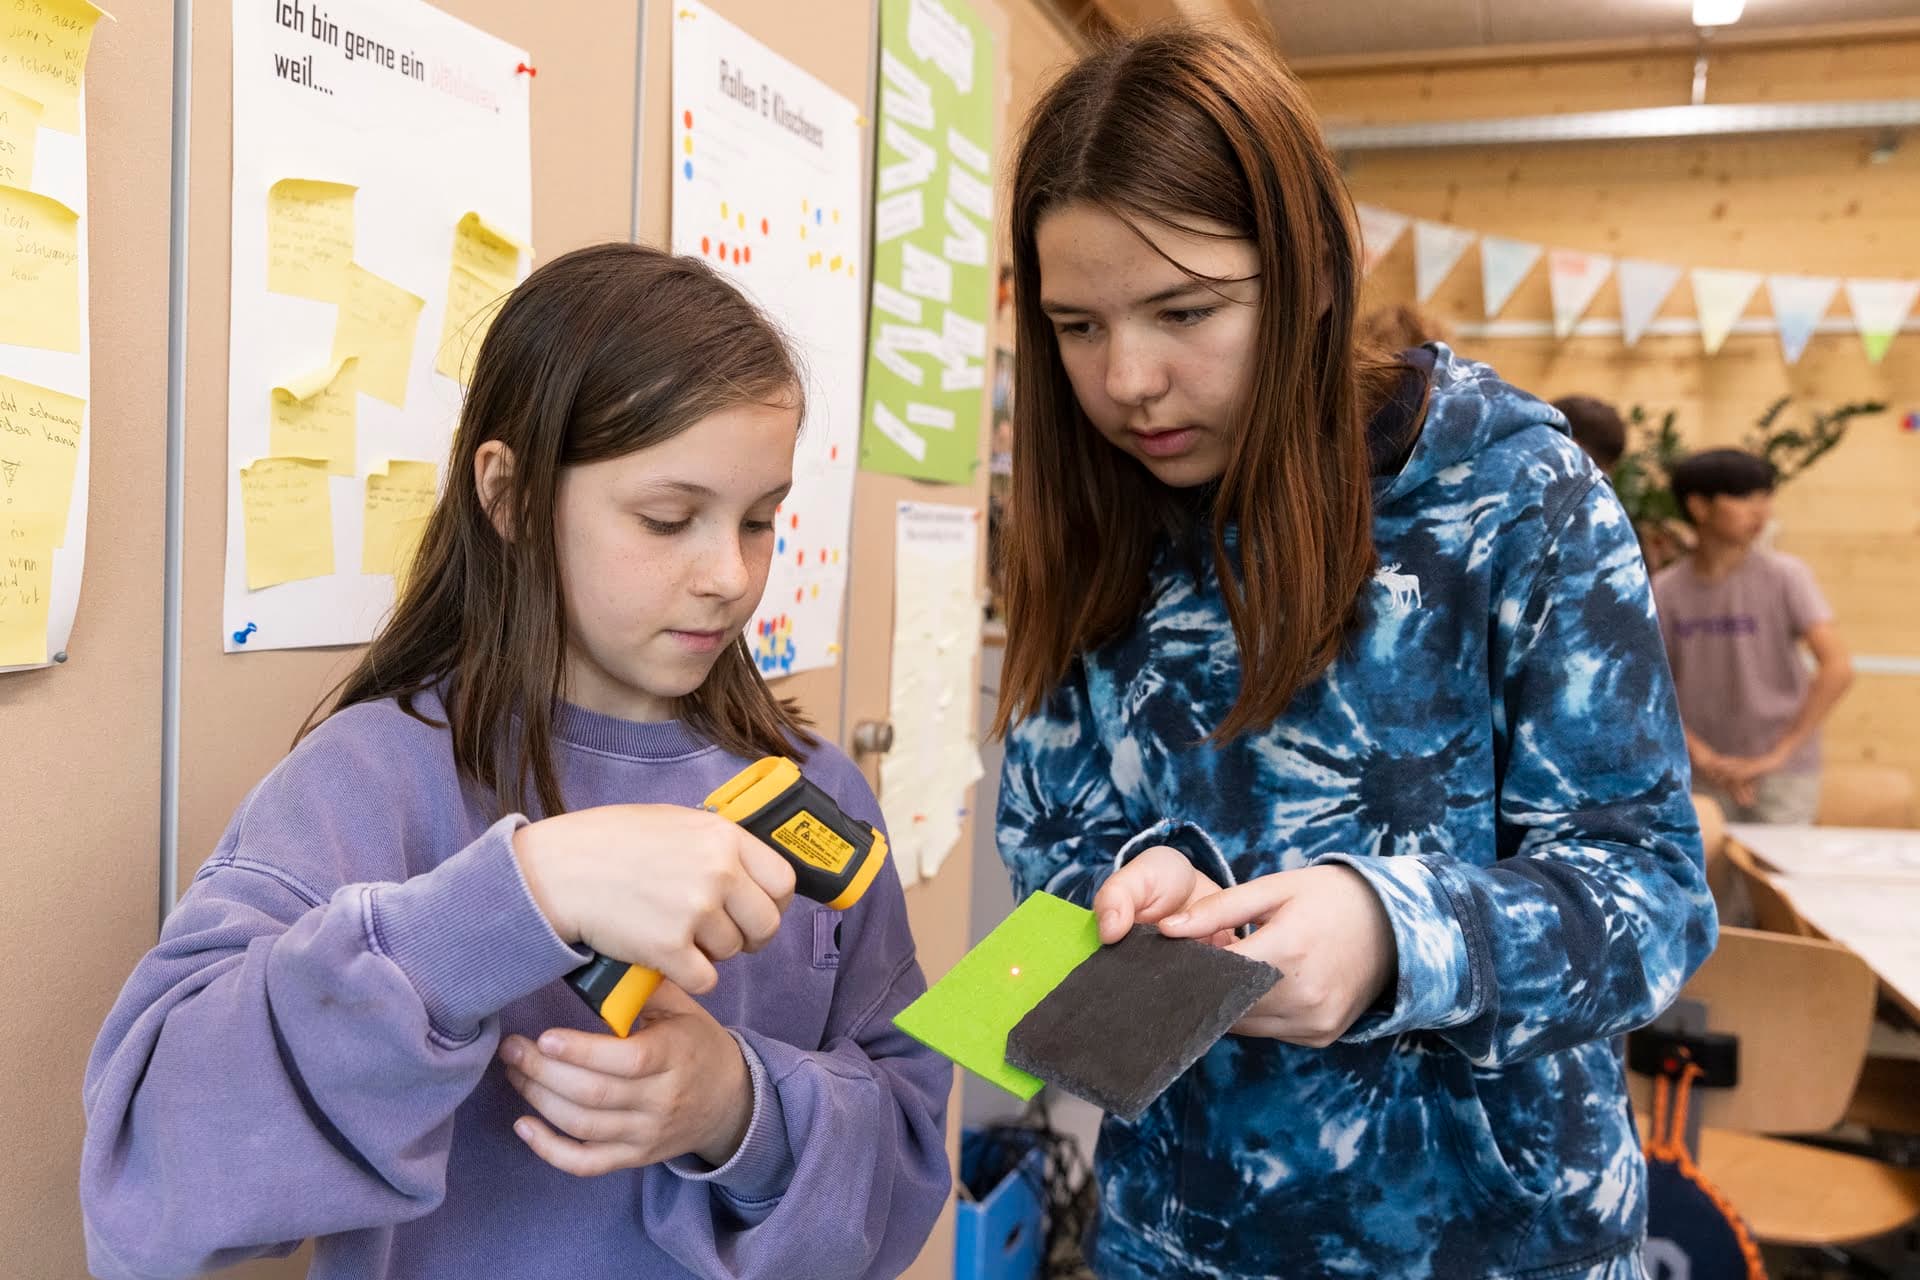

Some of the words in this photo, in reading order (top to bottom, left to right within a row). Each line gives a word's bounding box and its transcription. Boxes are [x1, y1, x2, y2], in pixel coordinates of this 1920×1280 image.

[276, 0, 304, 33] Ich
[312, 4, 338, 47] bin
[345, 30, 395, 70] gerne
[401, 51, 425, 82] ein
[720, 58, 757, 111] Rollen
